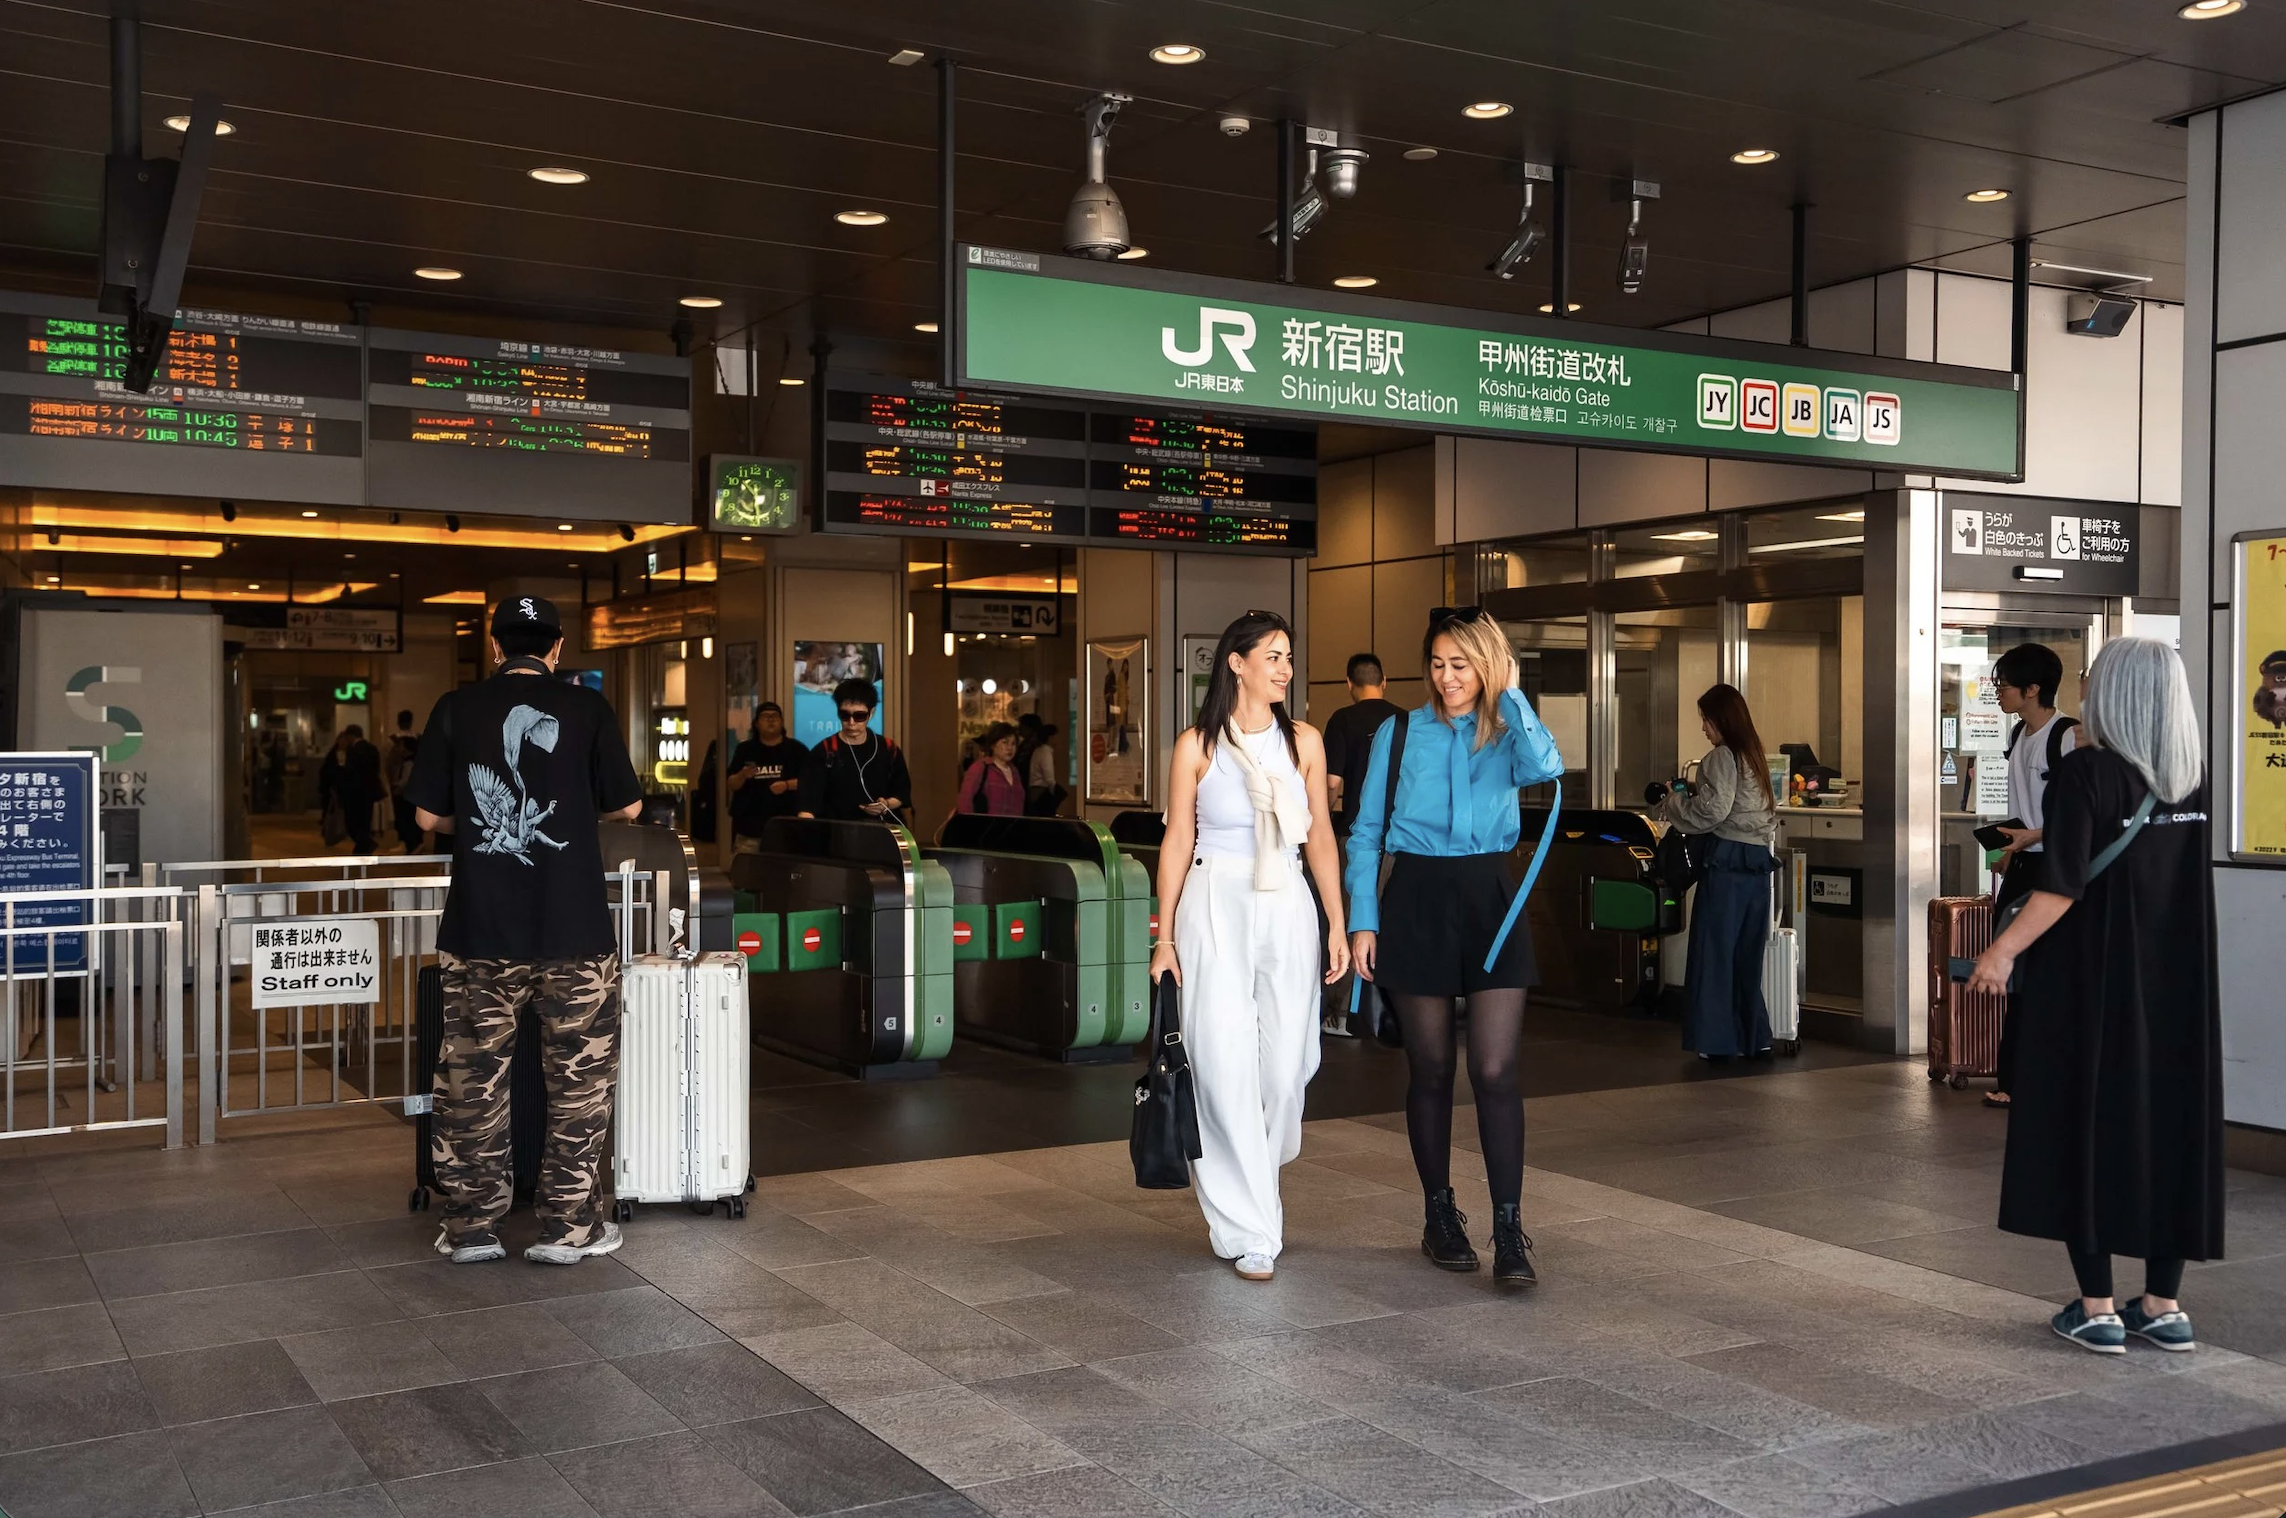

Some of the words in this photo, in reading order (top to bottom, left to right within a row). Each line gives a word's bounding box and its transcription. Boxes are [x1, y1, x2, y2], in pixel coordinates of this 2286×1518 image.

[1162, 306, 1257, 373] JR
[1281, 317, 1405, 378] 新宿駅
[1479, 340, 1632, 387] 甲州街道改札
[1175, 371, 1245, 394] JR東日本
[466, 393, 529, 406] 湘南新宿ライン
[1281, 374, 1377, 410] Shinjuku
[1385, 385, 1458, 415] Station
[1479, 377, 1571, 404] Kōshū-kaidō
[1576, 387, 1610, 407] Gate
[1706, 391, 1728, 413] JY
[1750, 395, 1770, 418] JC
[1792, 399, 1811, 420] JB
[1478, 400, 1567, 424] 甲州街道检票口
[1831, 403, 1853, 425] JA
[1873, 408, 1890, 429] JS
[1577, 411, 1637, 430] 고슈카이도
[1642, 417, 1678, 434] 개찰구
[750, 467, 761, 475] 12
[766, 470, 770, 478] 1
[728, 477, 740, 485] 10
[774, 479, 781, 487] 2
[779, 493, 787, 501] 3
[1985, 512, 2013, 527] うらが
[2082, 518, 2121, 535] 車椅子を
[1985, 530, 2044, 548] 白色のきっぷ
[2082, 536, 2130, 553] ご利用の方
[1985, 547, 2001, 557] White
[2003, 549, 2023, 558] Backed
[2025, 551, 2045, 559] Tickets
[2082, 552, 2090, 561] for
[2092, 553, 2124, 563] Wheelchair
[334, 682, 367, 700] JR
[0, 787, 65, 798] のお客さま
[1, 811, 65, 822] レーターで
[256, 928, 342, 948] 関係者以外の
[271, 949, 372, 970] 通行は出来ません
[261, 974, 319, 991] Staff
[324, 972, 374, 989] only
[1091, 1005, 1096, 1013] 4
[1134, 1002, 1140, 1010] 3
[888, 1019, 894, 1028] 5
[936, 1016, 942, 1024] 4
